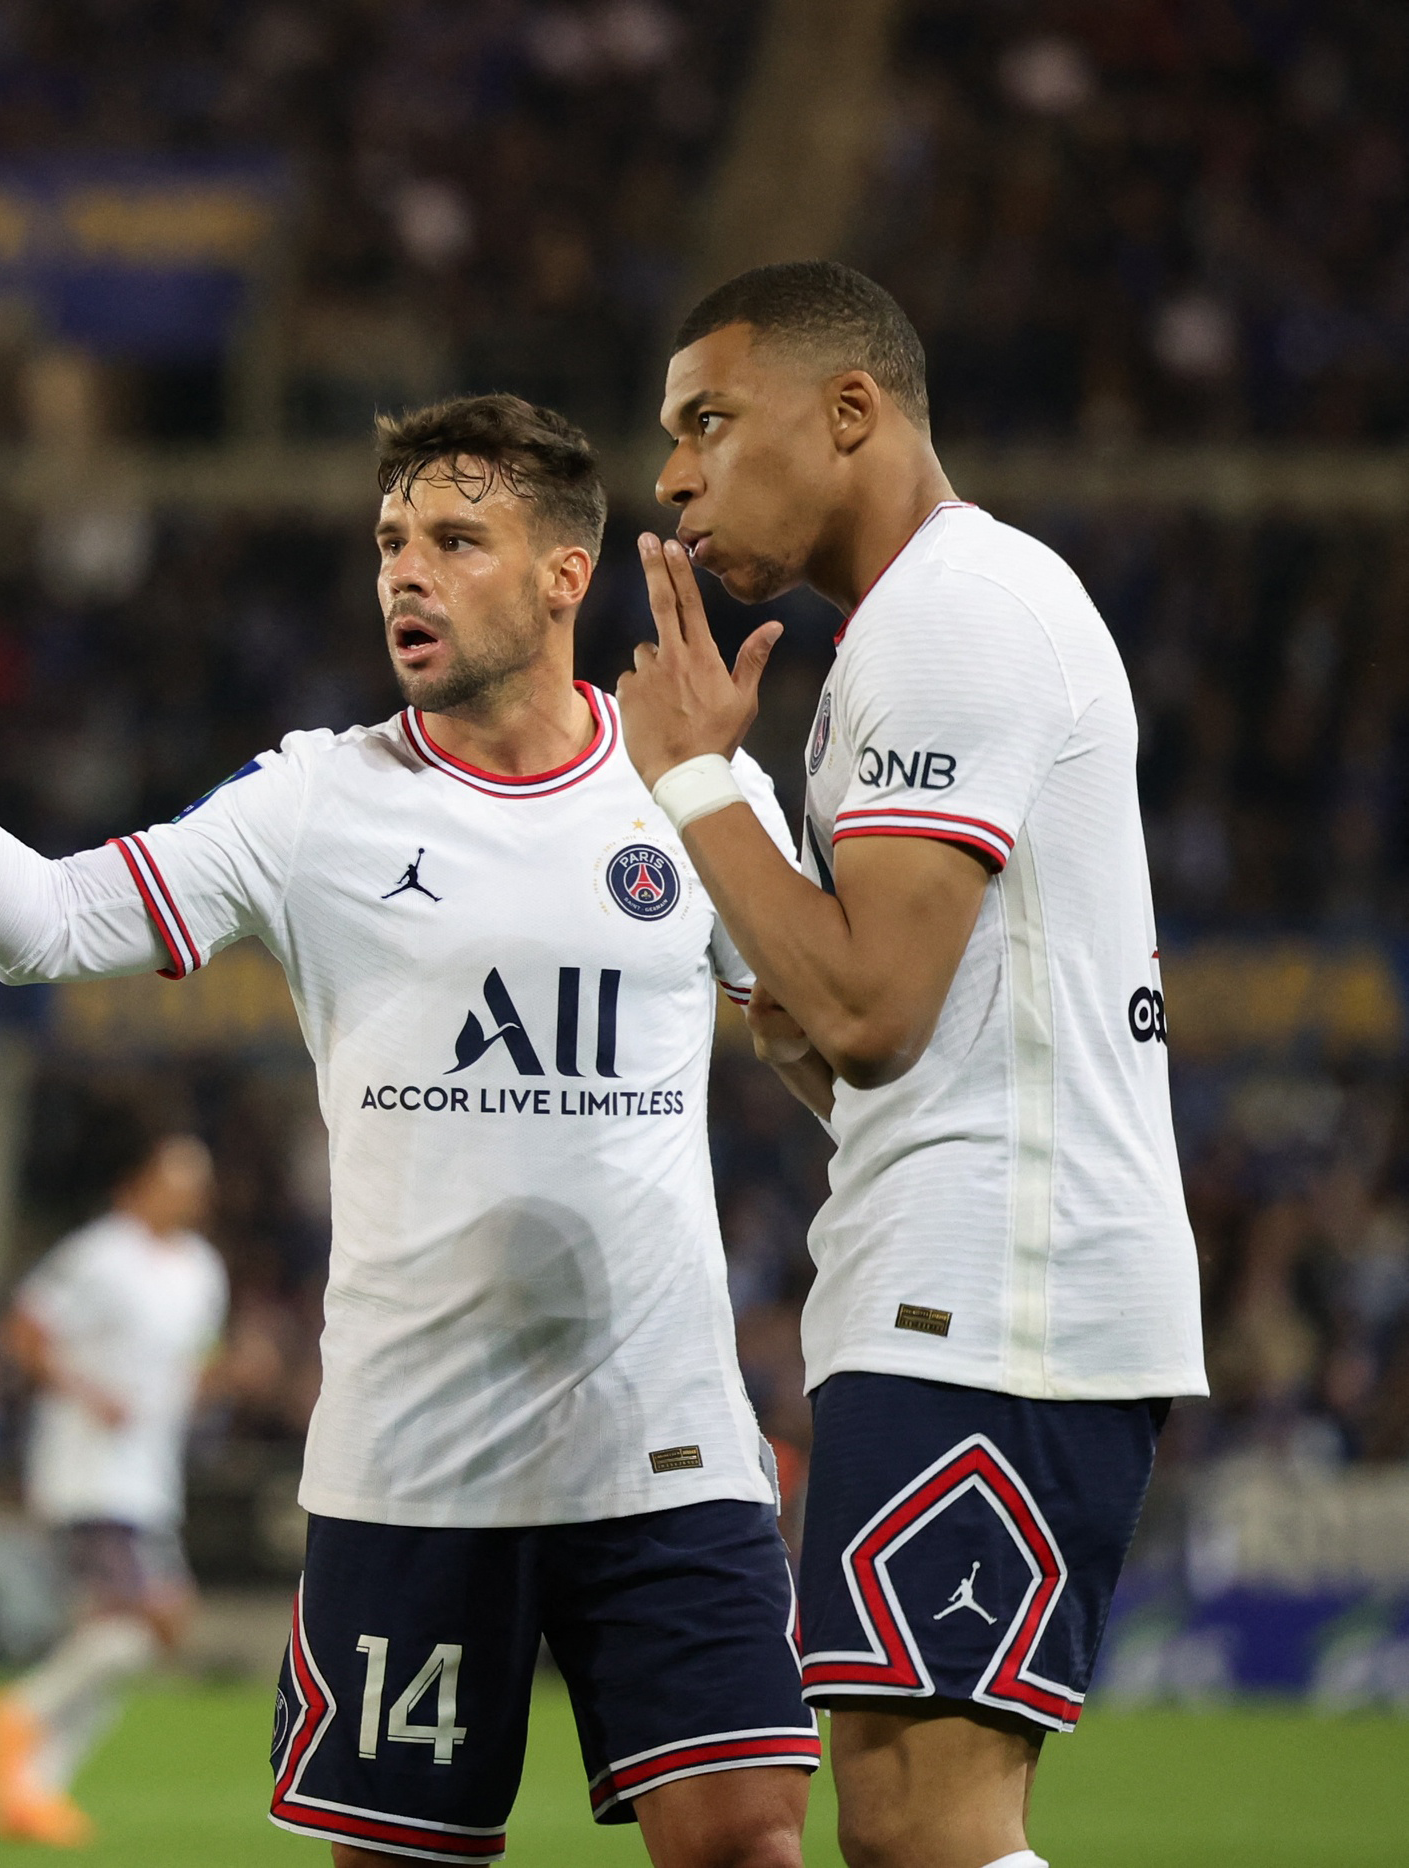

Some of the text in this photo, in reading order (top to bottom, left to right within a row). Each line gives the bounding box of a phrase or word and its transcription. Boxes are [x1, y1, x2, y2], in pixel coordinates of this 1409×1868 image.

[858, 747, 957, 789] QNB
[619, 851, 665, 869] PARIS
[361, 1085, 684, 1117] ACCOR LIVE LIMITLESS
[356, 1634, 467, 1765] 14
